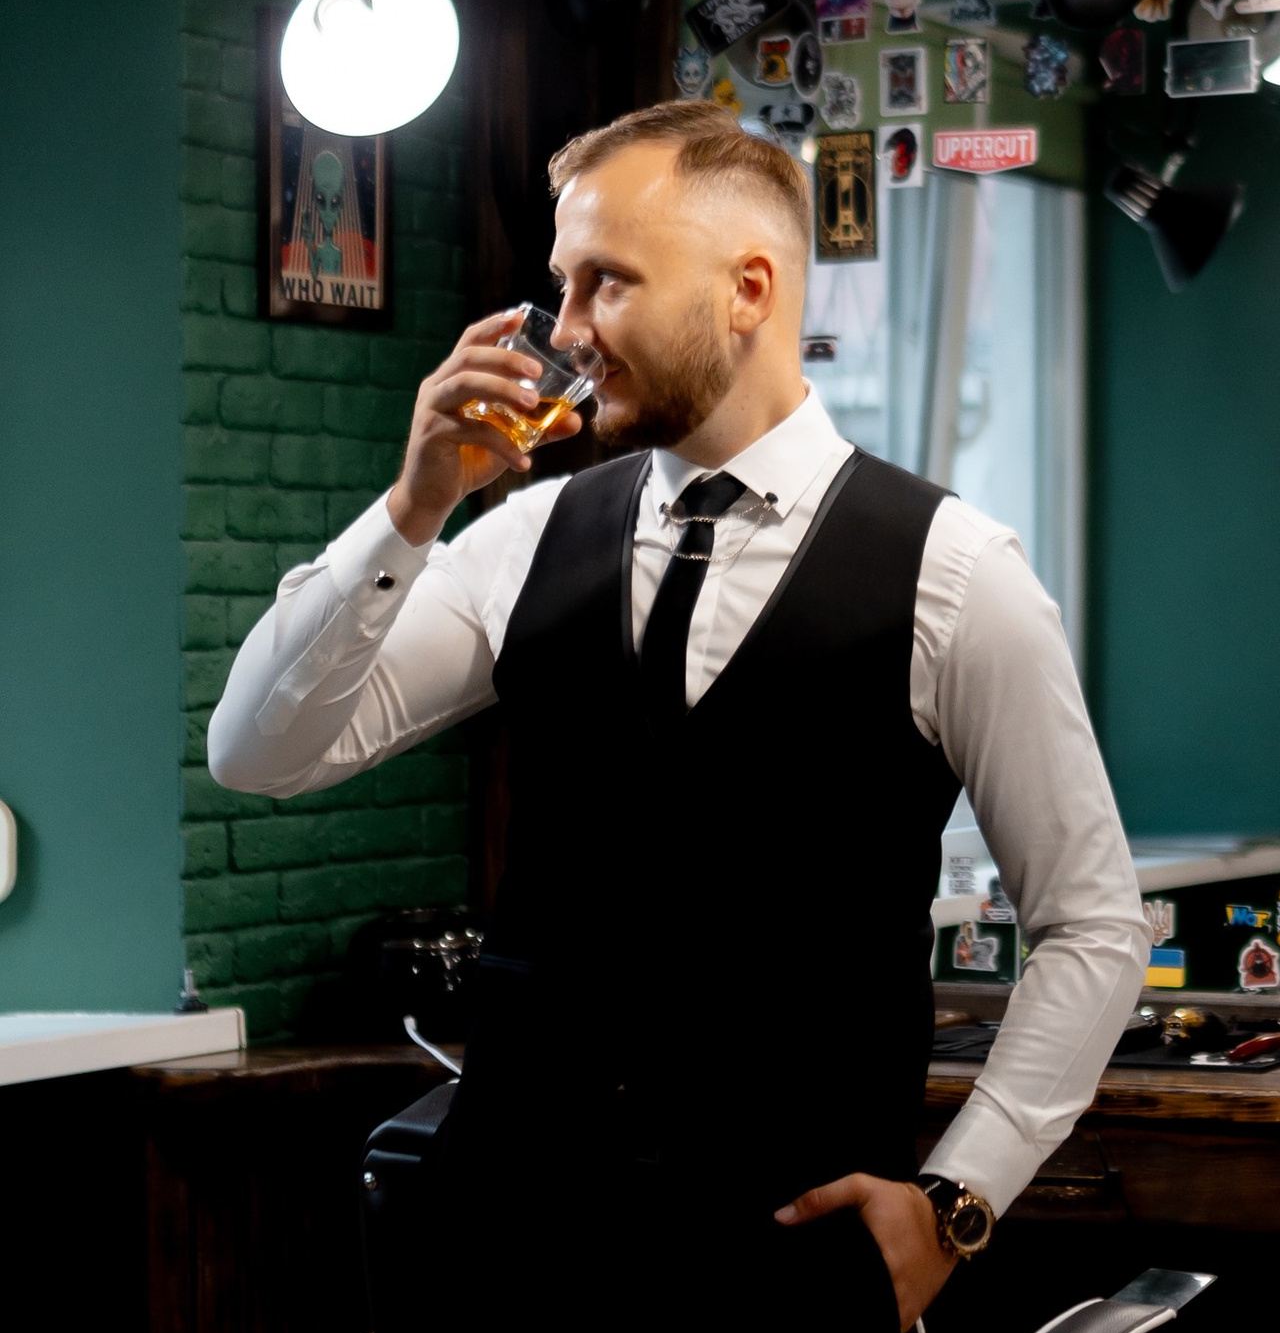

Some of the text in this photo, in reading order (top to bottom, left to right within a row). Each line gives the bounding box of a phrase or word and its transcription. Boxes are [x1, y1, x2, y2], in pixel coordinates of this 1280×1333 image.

[937, 135, 1029, 164] UPPERCUT
[281, 276, 377, 309] WHO WAIT
